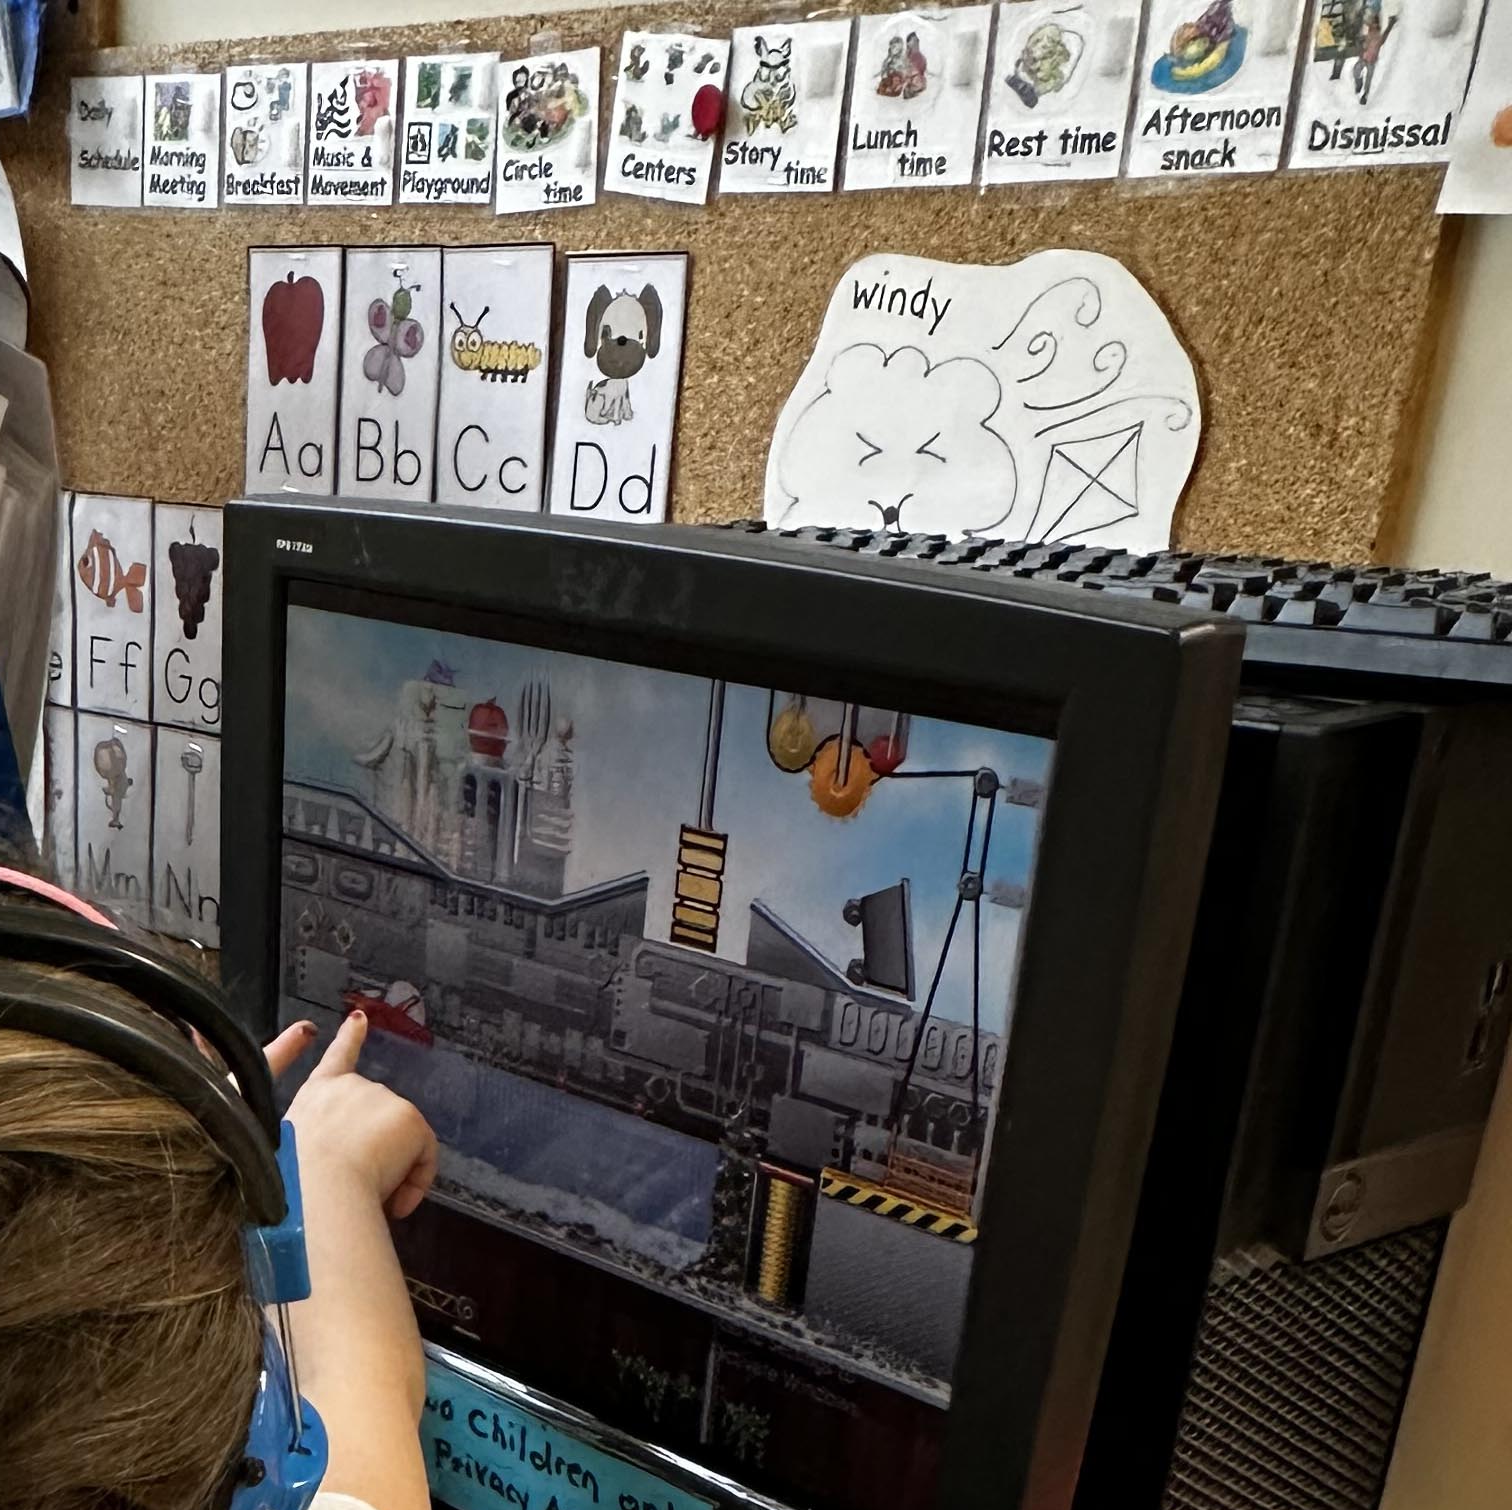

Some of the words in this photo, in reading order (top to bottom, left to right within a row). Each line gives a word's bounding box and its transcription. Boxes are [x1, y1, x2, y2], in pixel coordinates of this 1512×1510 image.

[853, 120, 918, 151] Lunch
[1143, 104, 1281, 137] Afternoon
[1308, 113, 1453, 152] Dismissal
[312, 145, 353, 168] Music
[360, 150, 372, 168] &
[724, 141, 782, 171] Story
[988, 129, 1048, 157] Rest
[1059, 126, 1116, 155] time
[1160, 138, 1237, 171] snack
[149, 145, 206, 174] Morning
[503, 156, 553, 182] Circle
[621, 153, 696, 187] Centers
[784, 160, 828, 185] time
[898, 152, 947, 177] time
[149, 173, 206, 200] Meeting
[225, 172, 301, 197] Breakfast
[310, 175, 388, 198] Movement
[402, 169, 490, 199] Playground
[544, 181, 583, 205] time
[852, 270, 952, 335] windy
[468, 1408, 599, 1503] Children
